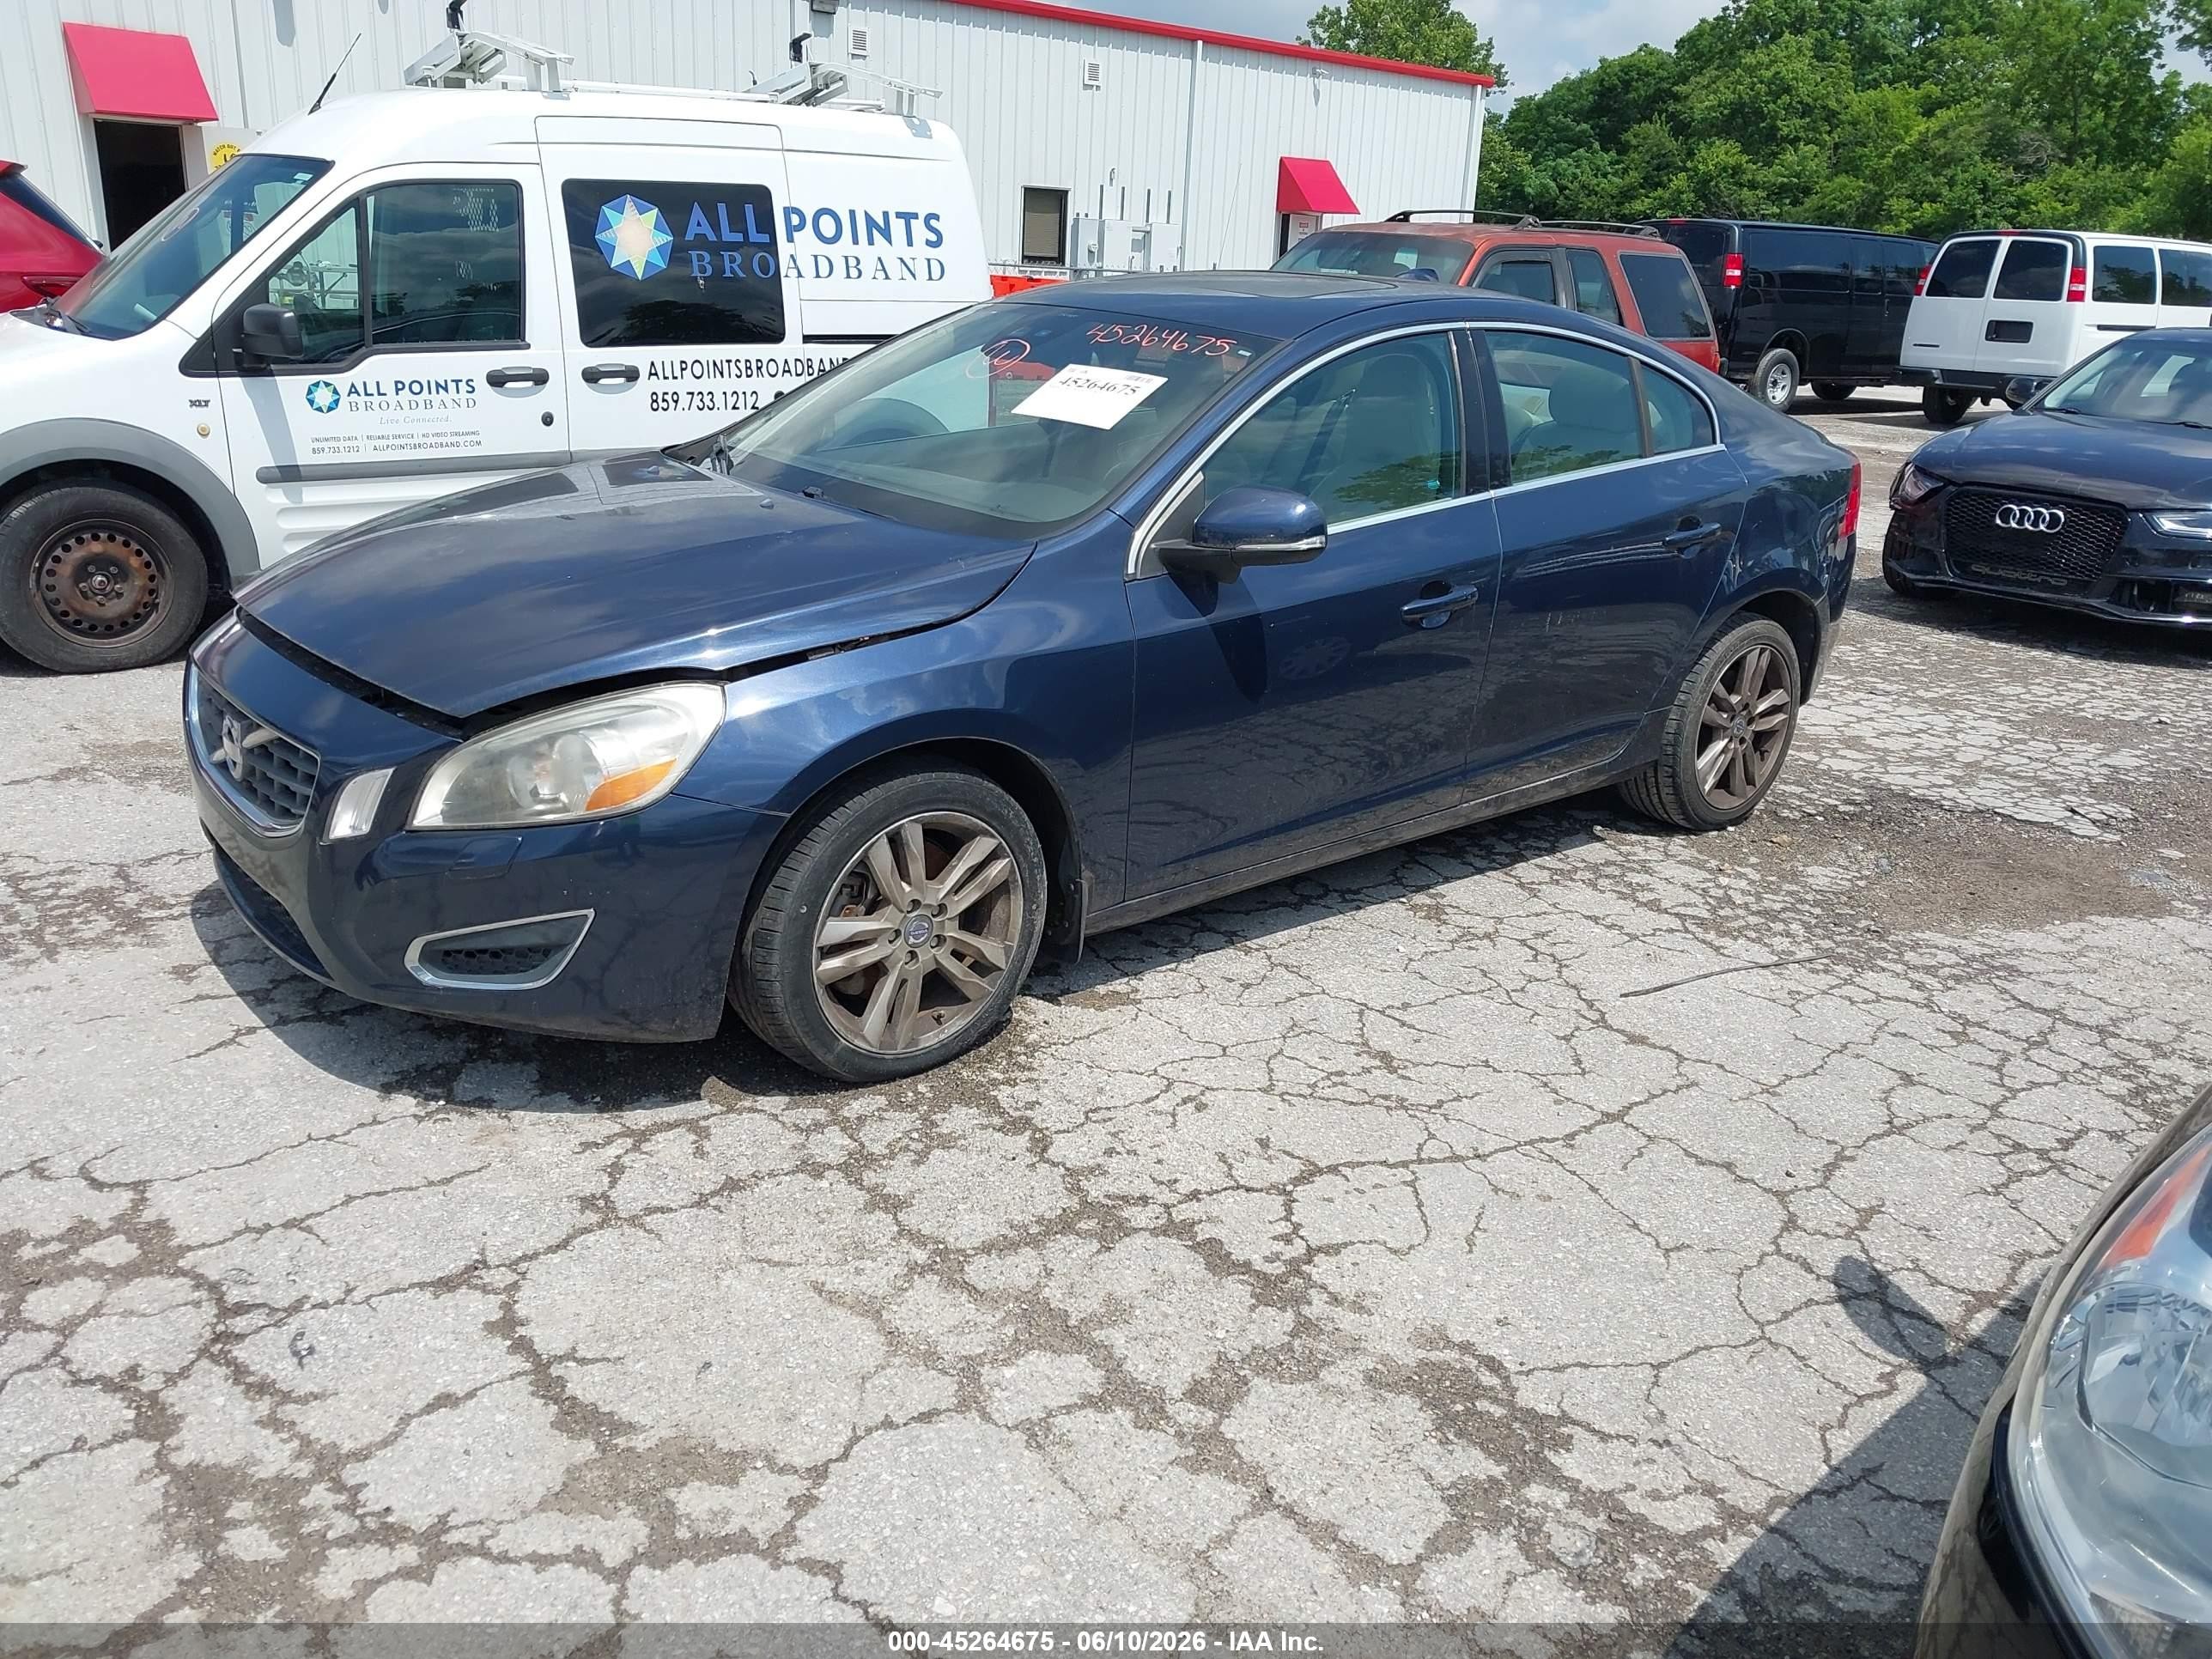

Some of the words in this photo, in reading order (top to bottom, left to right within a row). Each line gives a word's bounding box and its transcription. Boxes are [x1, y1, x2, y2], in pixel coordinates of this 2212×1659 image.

[685, 201, 770, 244] ALL
[782, 206, 944, 248] POINTS
[688, 250, 946, 282] BROADBAND
[1085, 324, 1237, 356] 45264675
[347, 380, 387, 398] ALL
[394, 379, 476, 396] POINTS
[349, 398, 477, 412] BROADBAND
[650, 391, 760, 412] 859.733.1212
[379, 416, 399, 425] Live
[312, 445, 360, 454] 859.733.1212
[373, 440, 482, 452] ALLPOINTSBROADBAND.COM
